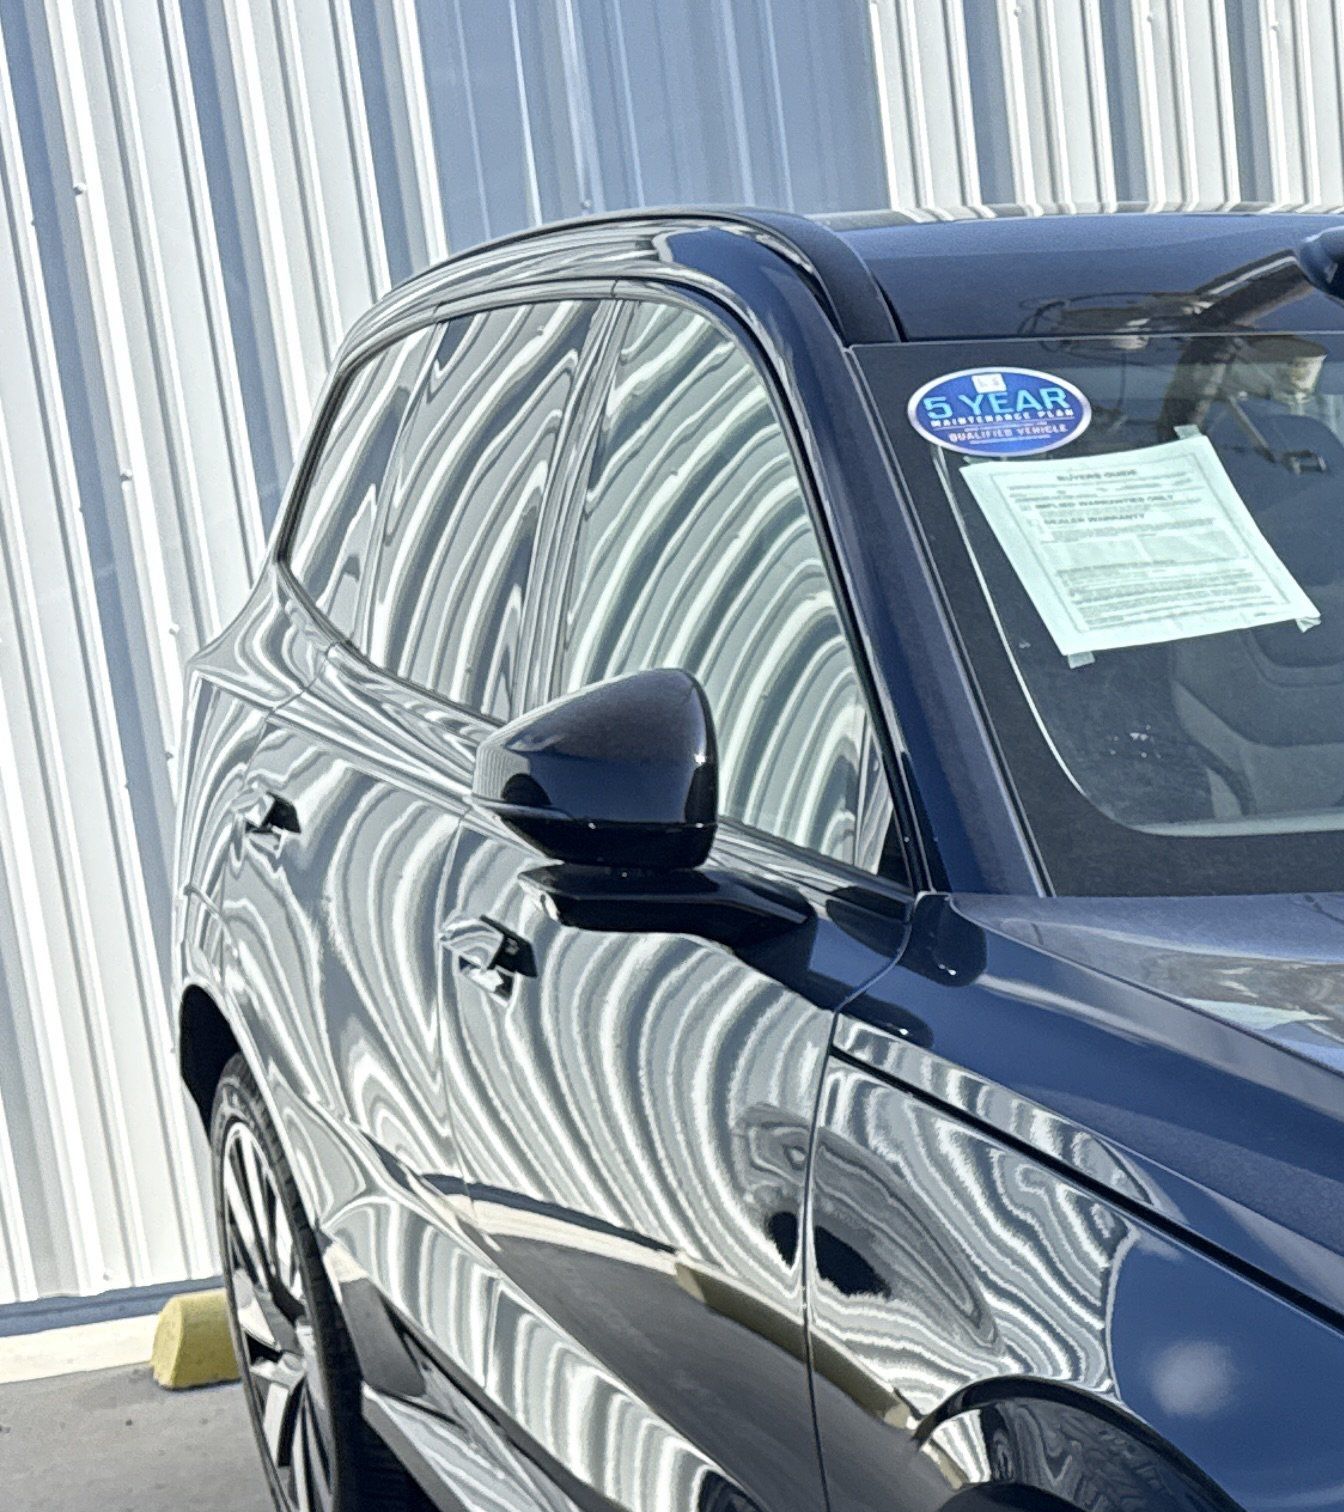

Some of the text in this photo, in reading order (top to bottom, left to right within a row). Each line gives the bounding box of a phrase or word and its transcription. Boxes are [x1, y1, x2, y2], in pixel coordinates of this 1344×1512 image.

[923, 387, 1071, 420] 5 YEAR
[930, 412, 1031, 428] MAINTENANCE
[1037, 408, 1075, 419] PLAN
[948, 428, 1013, 443] QUALIFIED
[1016, 423, 1069, 436] VEHICLE
[1104, 469, 1138, 479] GUIDE
[1088, 512, 1145, 523] WARRANTY
